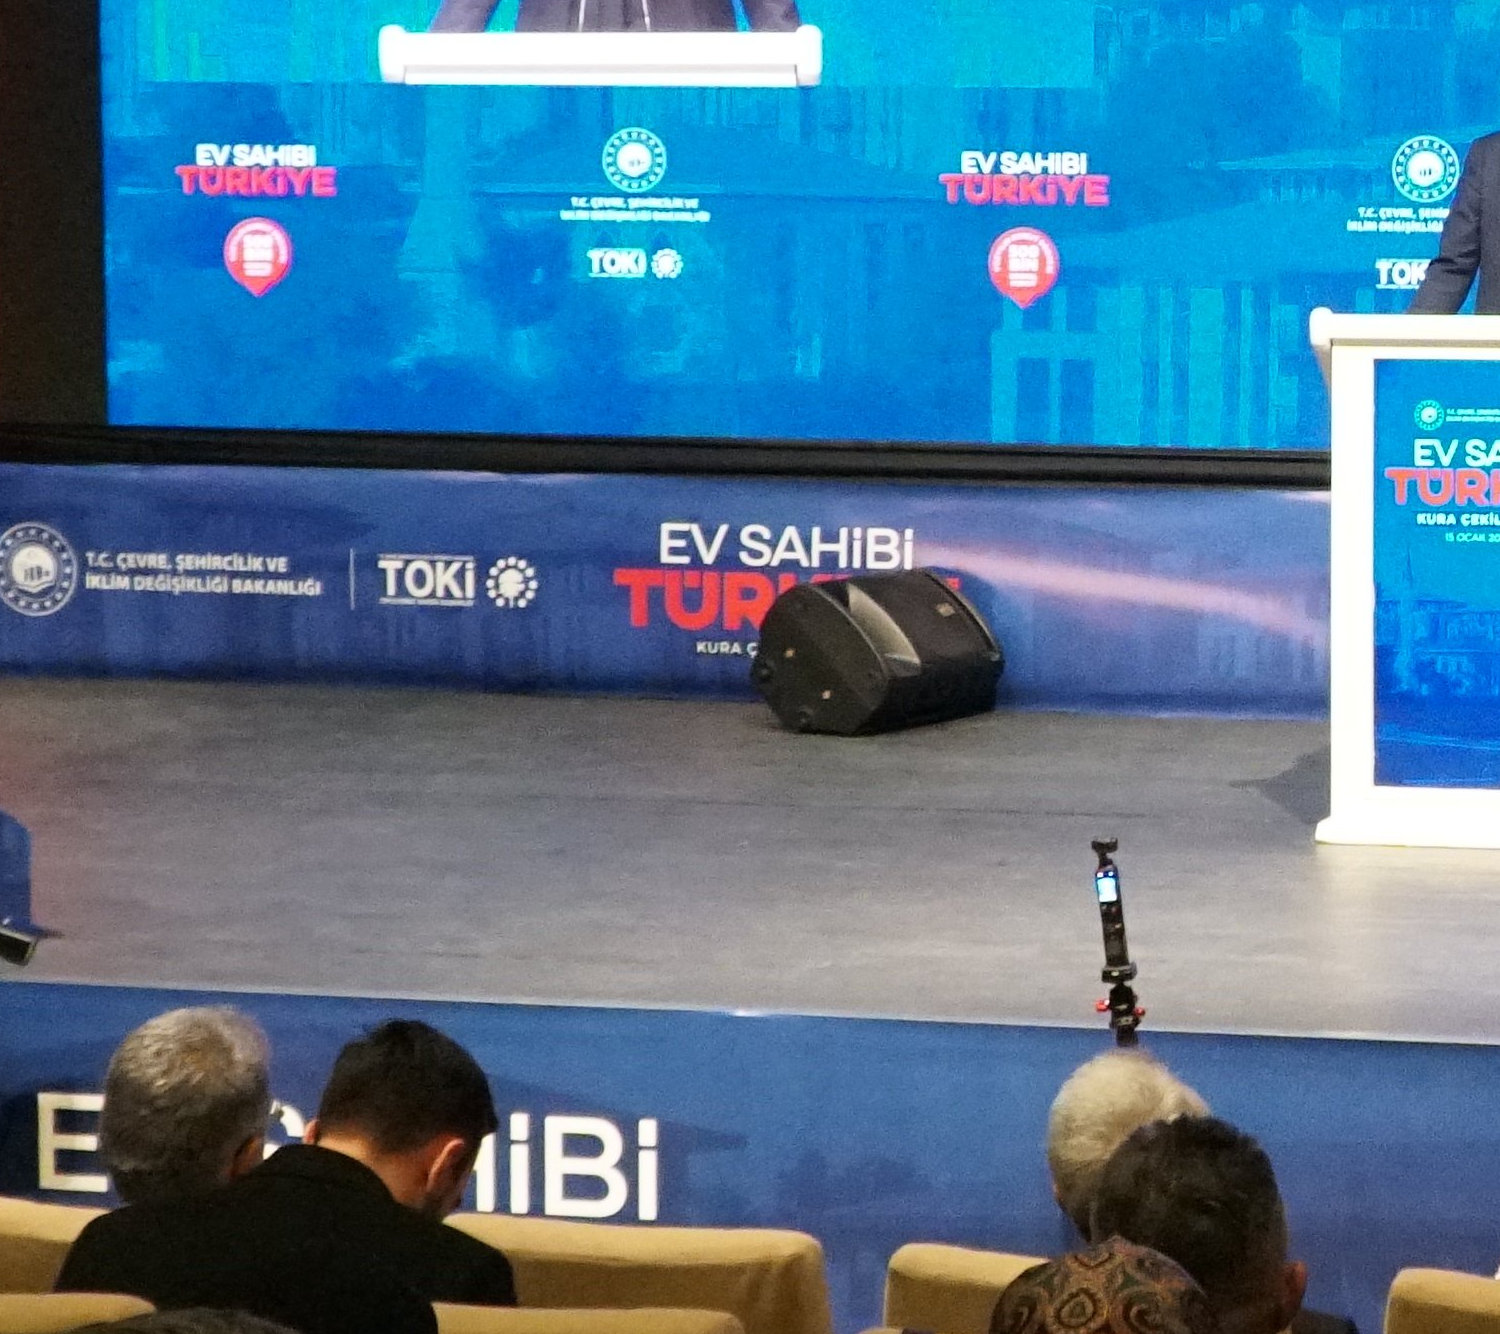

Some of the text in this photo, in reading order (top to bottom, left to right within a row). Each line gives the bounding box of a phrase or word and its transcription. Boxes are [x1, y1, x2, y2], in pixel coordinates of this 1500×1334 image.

[195, 143, 231, 166] EV
[961, 151, 997, 174] EV
[1375, 261, 1429, 285] TOK
[1414, 439, 1458, 467] EV
[1417, 513, 1456, 526] KURA
[659, 522, 730, 565] EV
[86, 550, 114, 568] T.C.
[266, 557, 288, 573] VE
[696, 642, 743, 655] KURA
